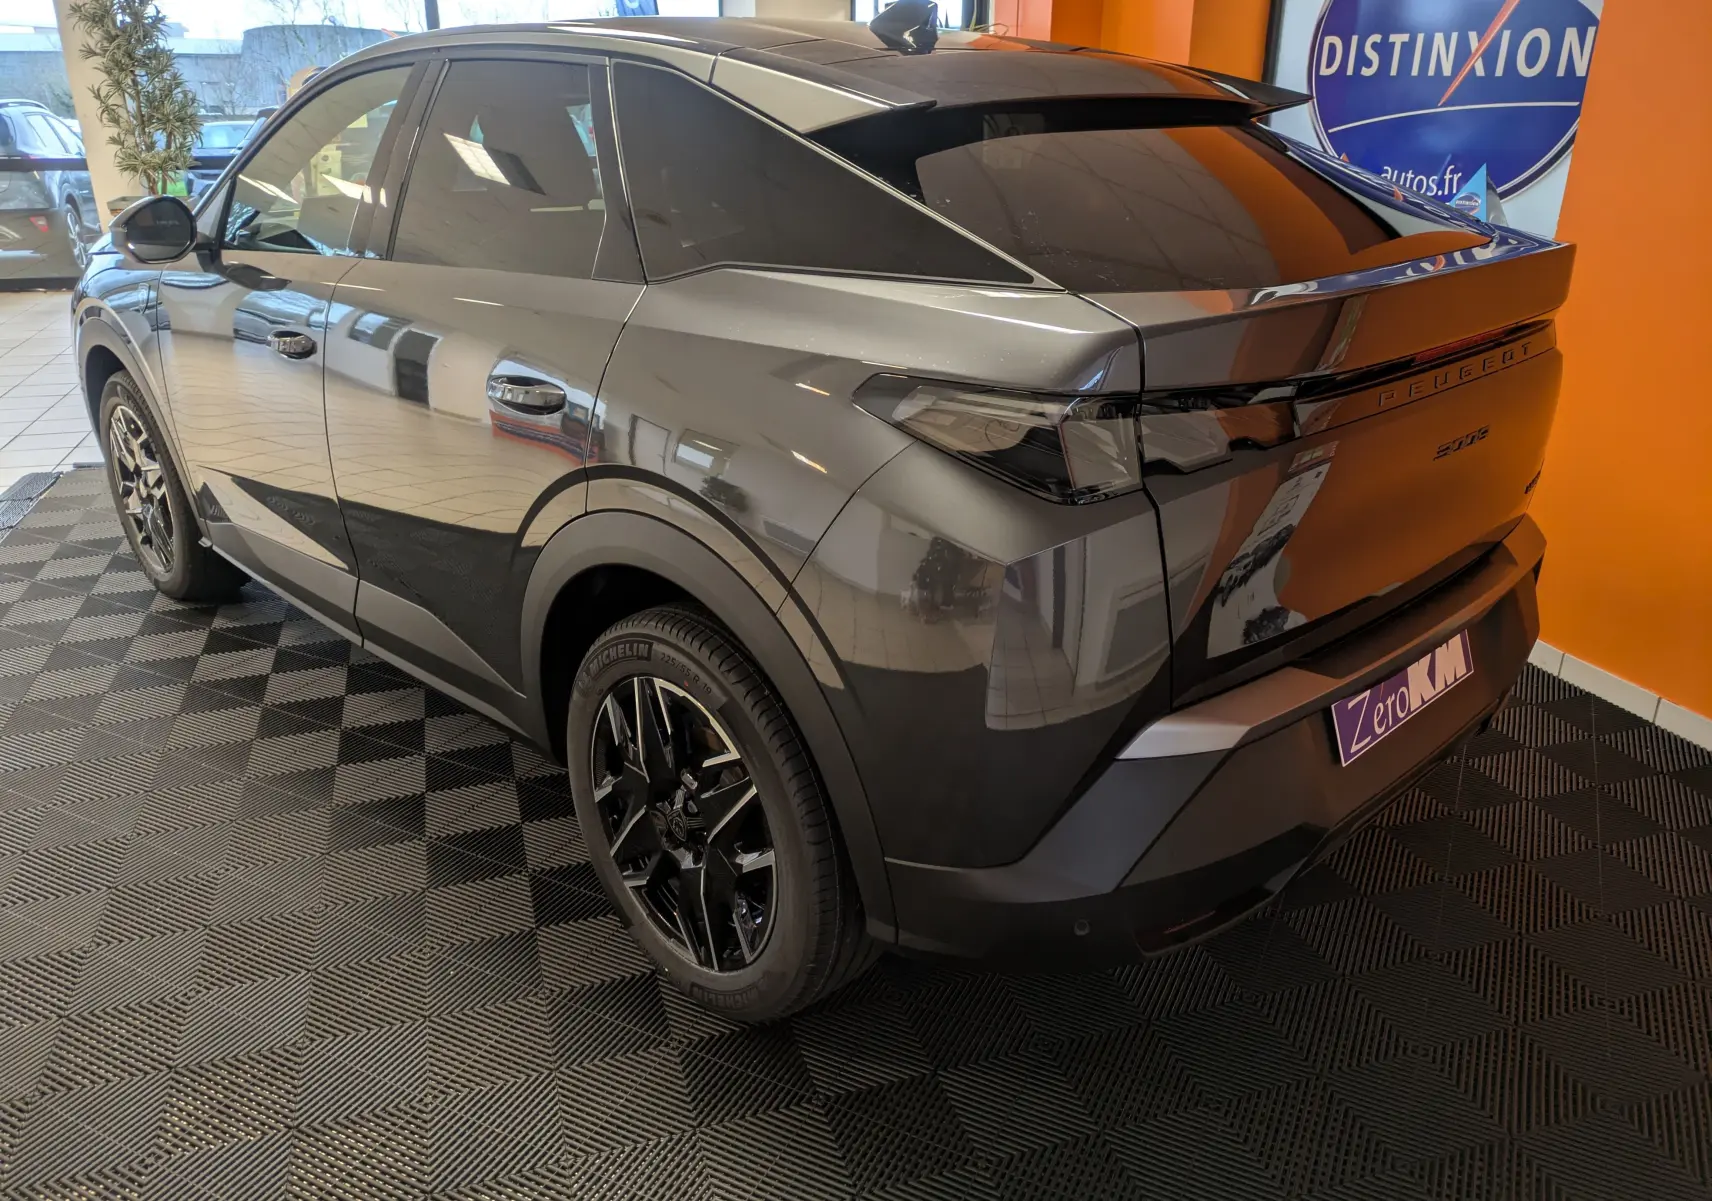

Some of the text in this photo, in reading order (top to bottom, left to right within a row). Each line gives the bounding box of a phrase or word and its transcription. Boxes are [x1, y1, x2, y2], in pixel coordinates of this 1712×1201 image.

[1319, 26, 1597, 78] DISTINXION
[1381, 164, 1463, 197] autos.fr
[1379, 343, 1534, 407] PEUGEOT
[589, 642, 650, 678] MICHELIN
[693, 675, 700, 685] R
